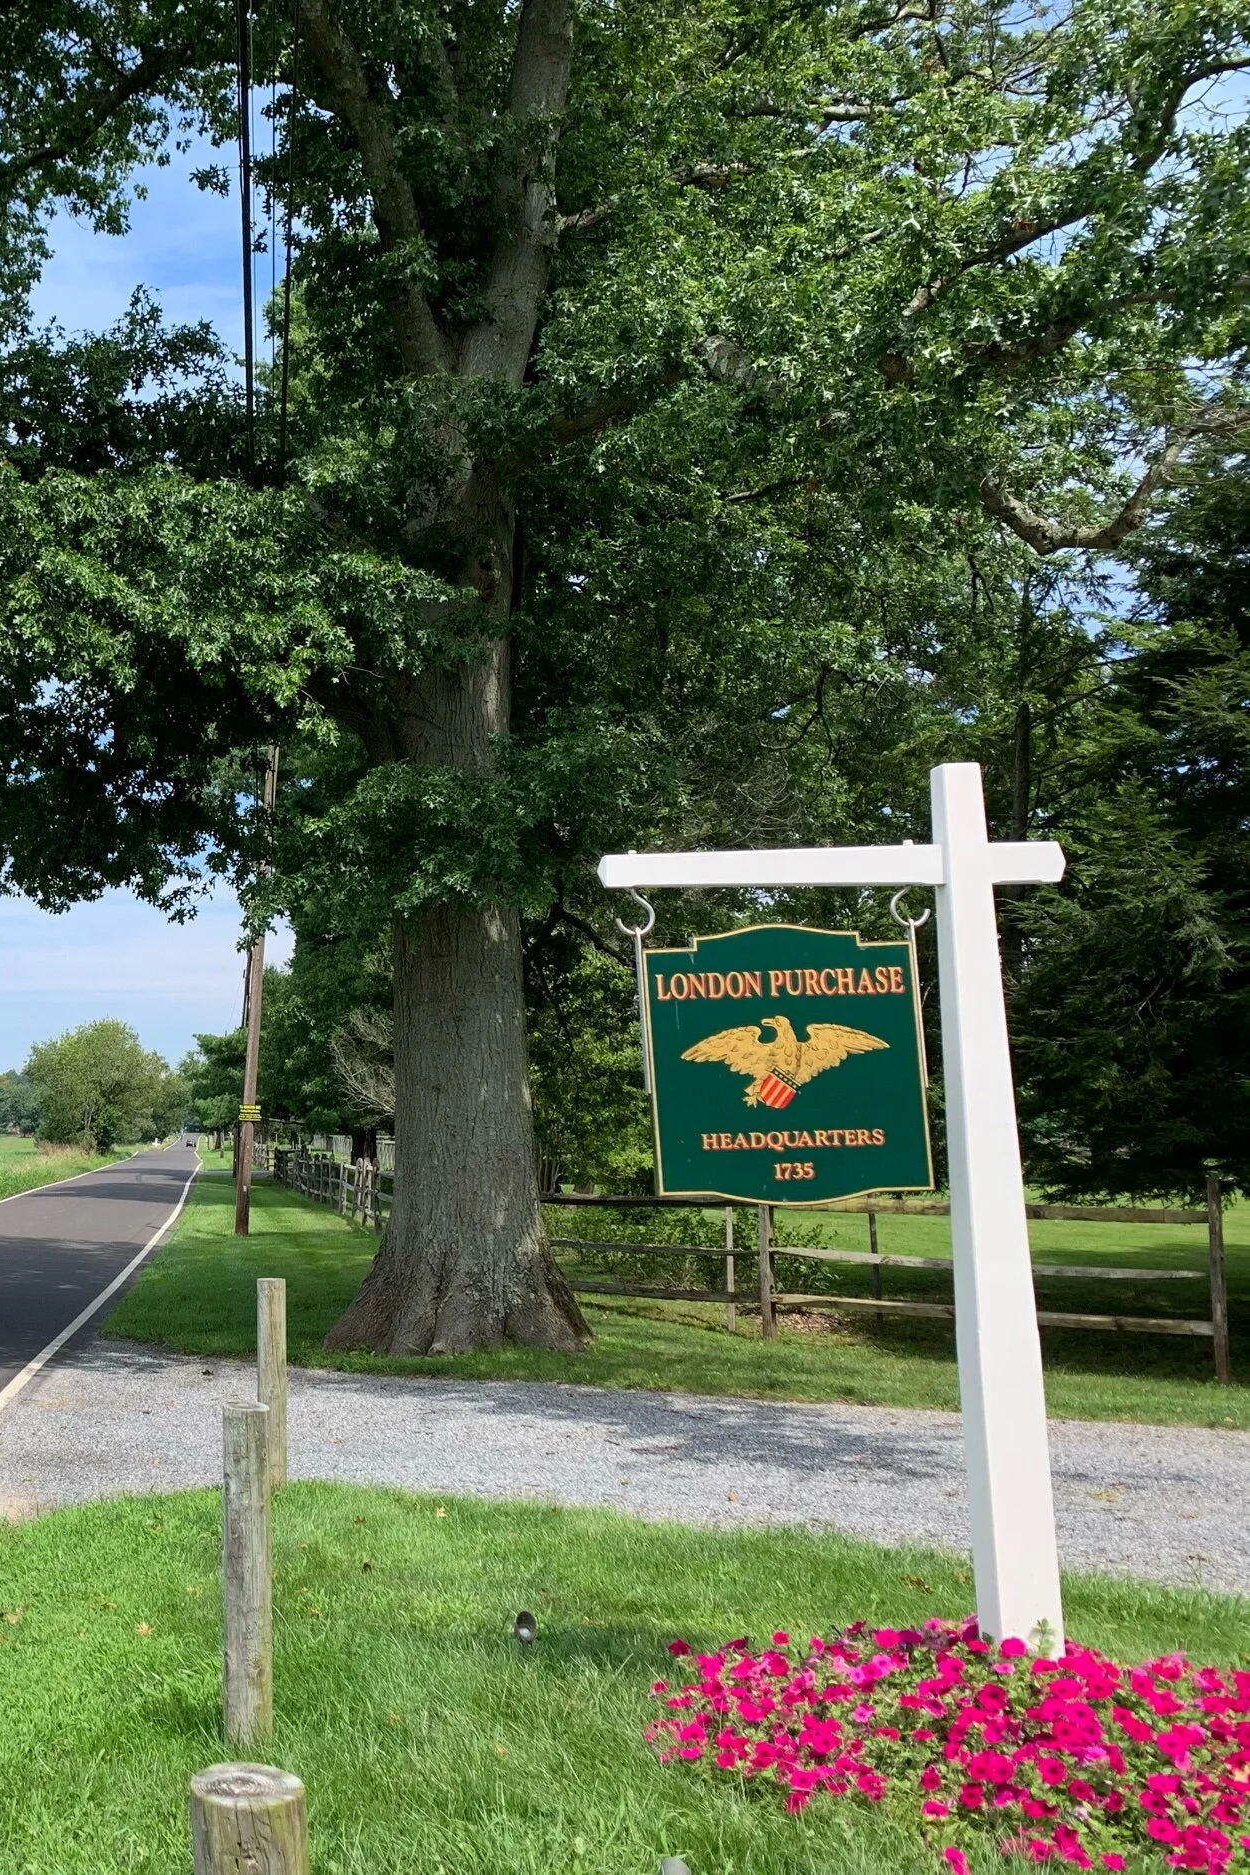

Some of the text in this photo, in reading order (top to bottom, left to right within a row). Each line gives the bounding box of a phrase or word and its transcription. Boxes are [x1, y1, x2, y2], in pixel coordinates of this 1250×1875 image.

[655, 966, 905, 1000] LONDON PURCHASE
[701, 1128, 885, 1151] HEADQUARTERS
[773, 1162, 815, 1181] 1735
